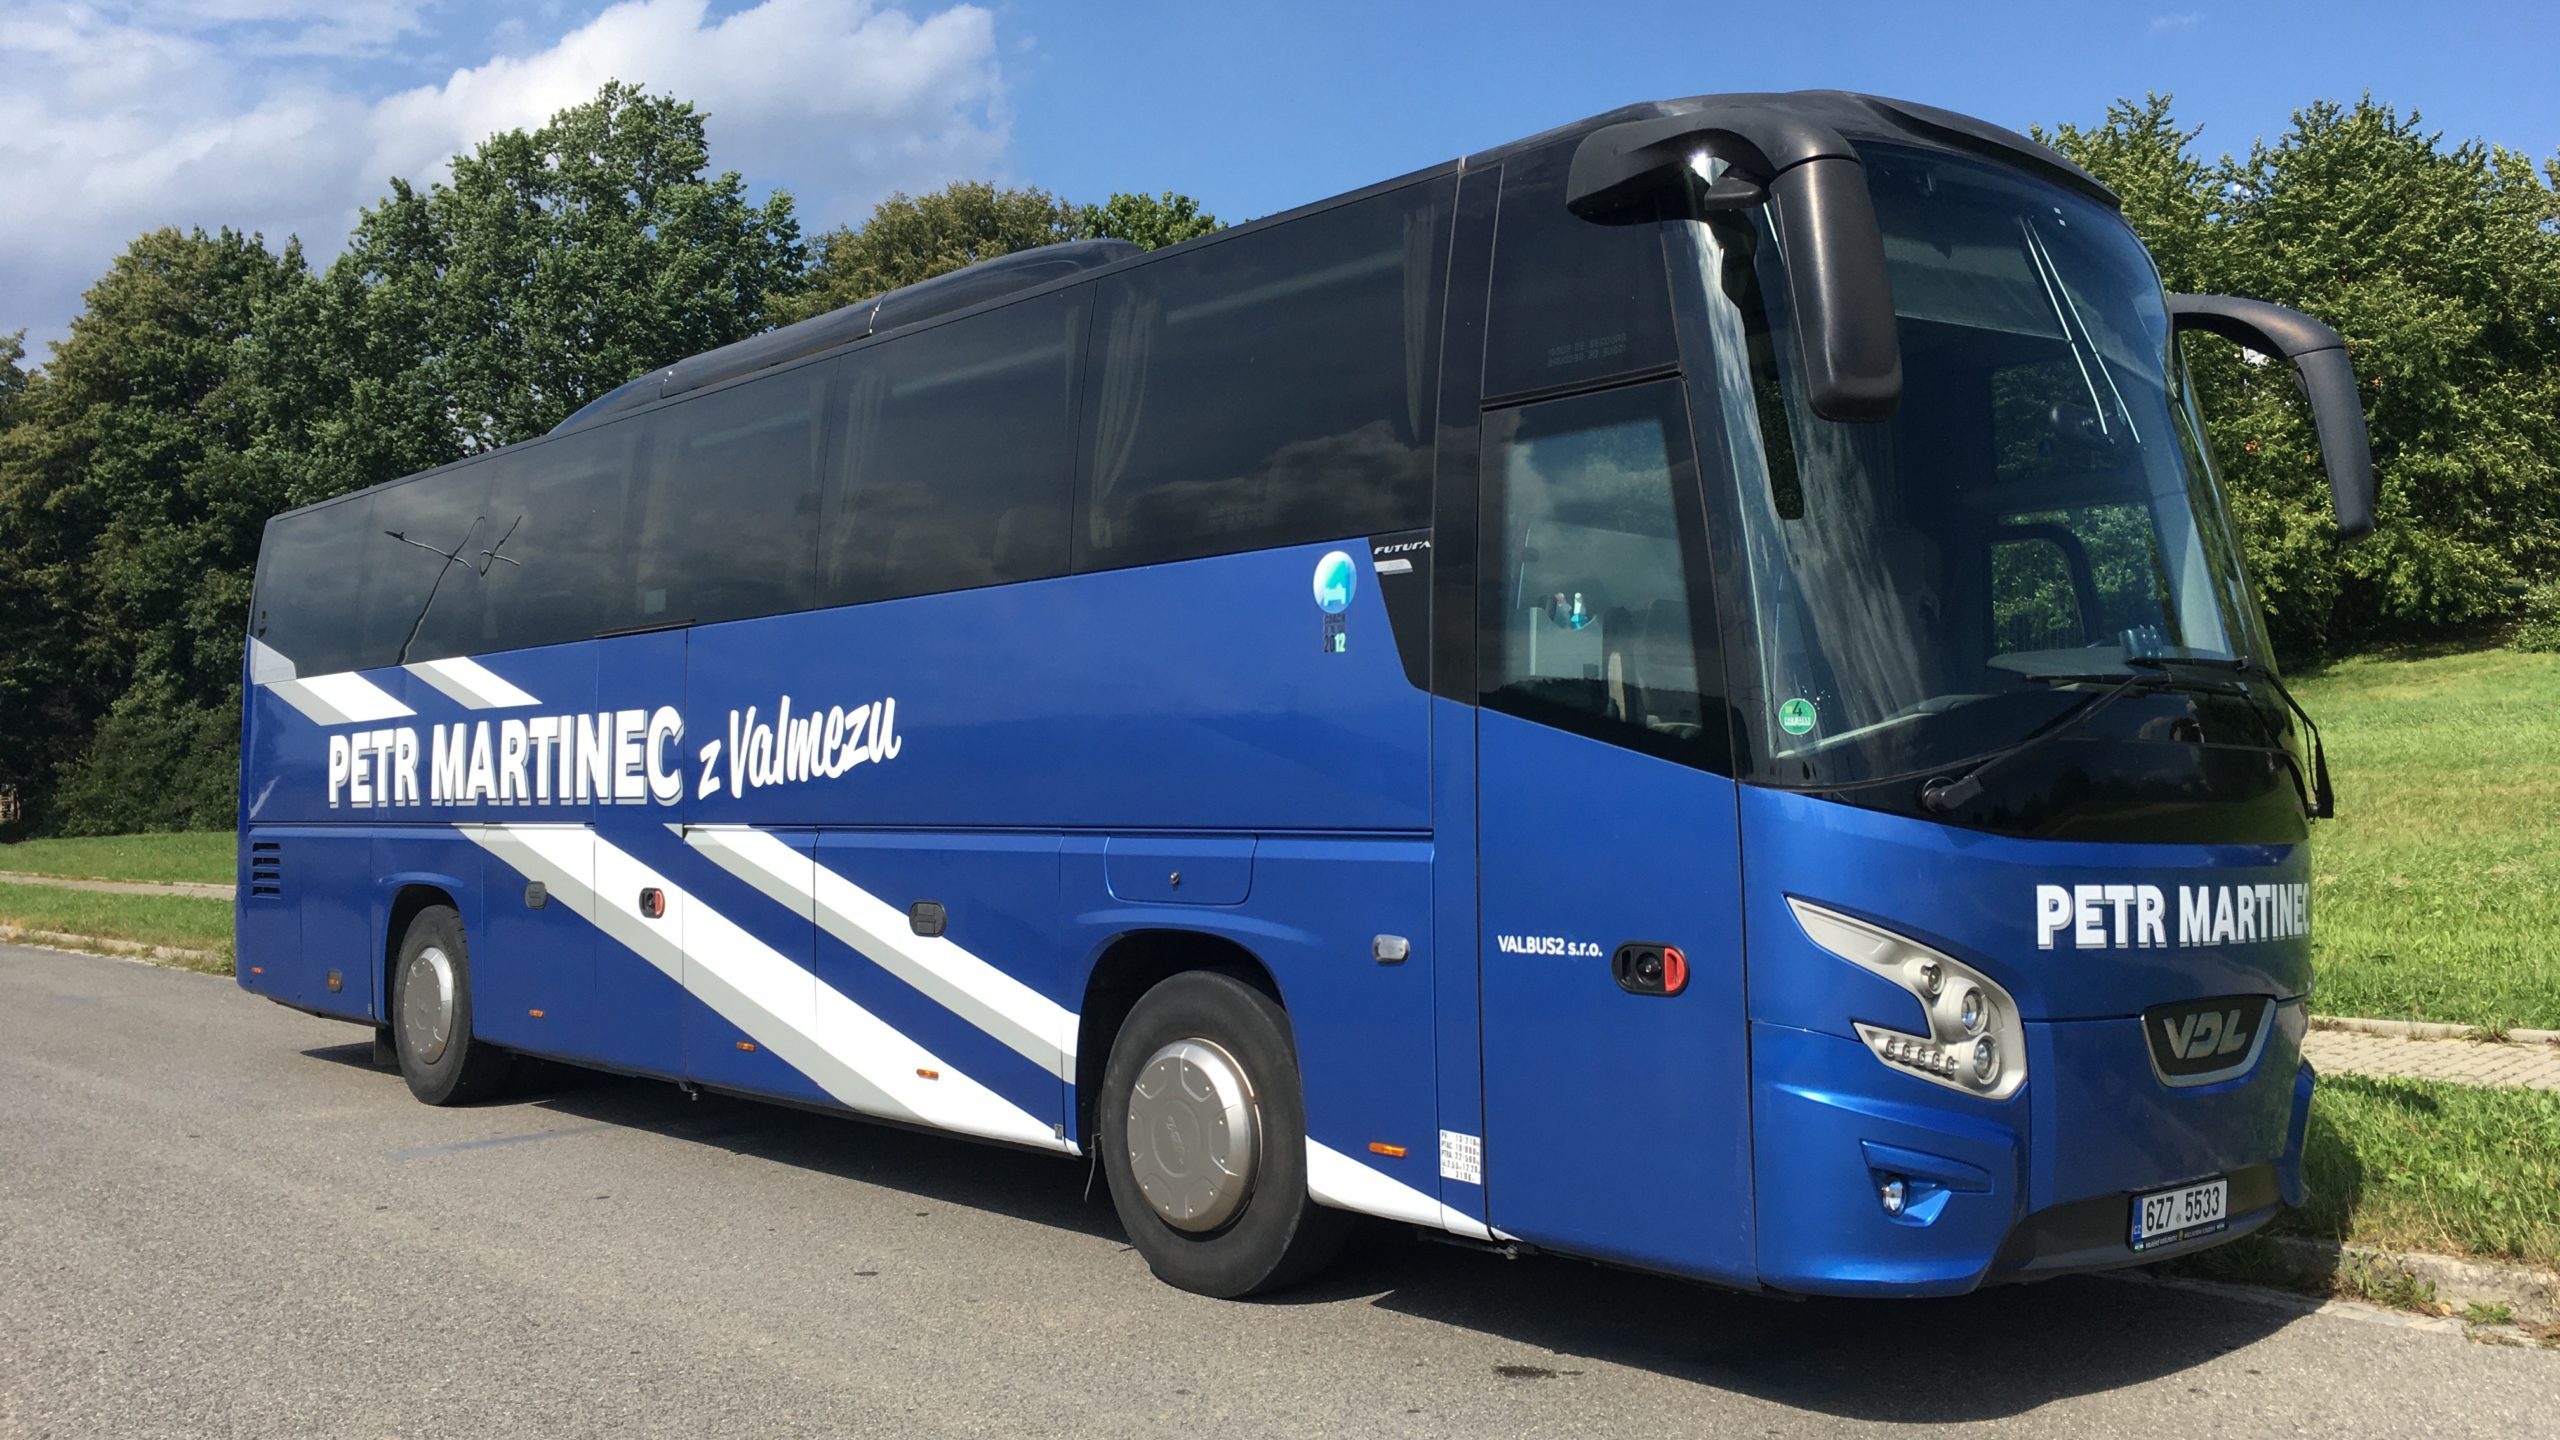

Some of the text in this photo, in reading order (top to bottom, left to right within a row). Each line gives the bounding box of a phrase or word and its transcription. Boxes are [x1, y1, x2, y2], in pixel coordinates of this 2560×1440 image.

[1374, 540, 1432, 555] FUTURA
[1324, 632, 1346, 653] 2012
[1792, 701, 1802, 716] 4
[329, 695, 902, 808] PETR MARTINEC z Valmezu
[2036, 885, 2168, 949] PETR
[1497, 934, 1604, 958] VALBUS2 s.r.o.
[2163, 1009, 2248, 1059] VDL
[2146, 1186, 2220, 1232] 6Z7 5533
